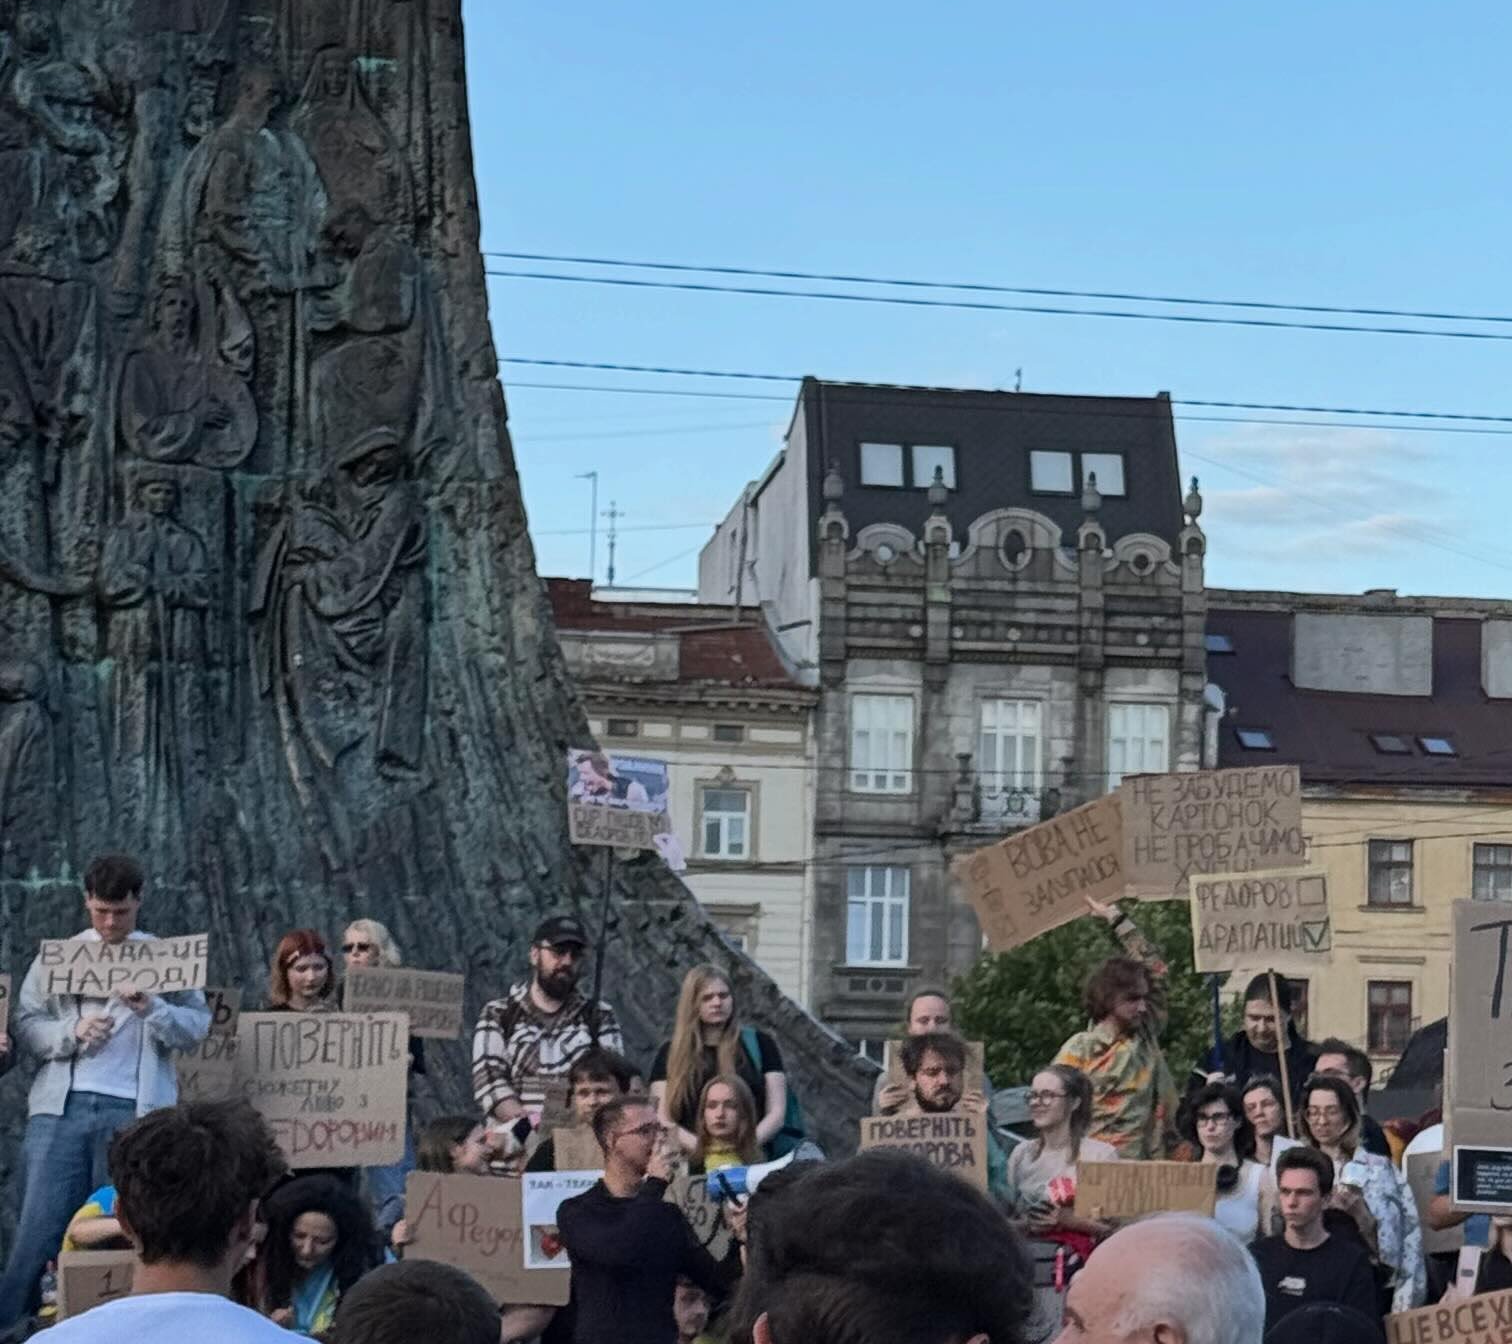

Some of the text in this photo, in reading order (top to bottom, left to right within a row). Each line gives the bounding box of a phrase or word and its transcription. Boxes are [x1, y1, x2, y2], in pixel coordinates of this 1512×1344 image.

[1134, 769, 1295, 806] НЕ ЗАБУДЕМО
[1151, 799, 1281, 831] КАРТОНОК
[1133, 834, 1168, 864] НЕ
[1194, 879, 1293, 912] ФЕДОРОВ
[869, 1116, 976, 1140] ПОВЕРНІТЬ
[1435, 1300, 1488, 1342] ВСЕ
